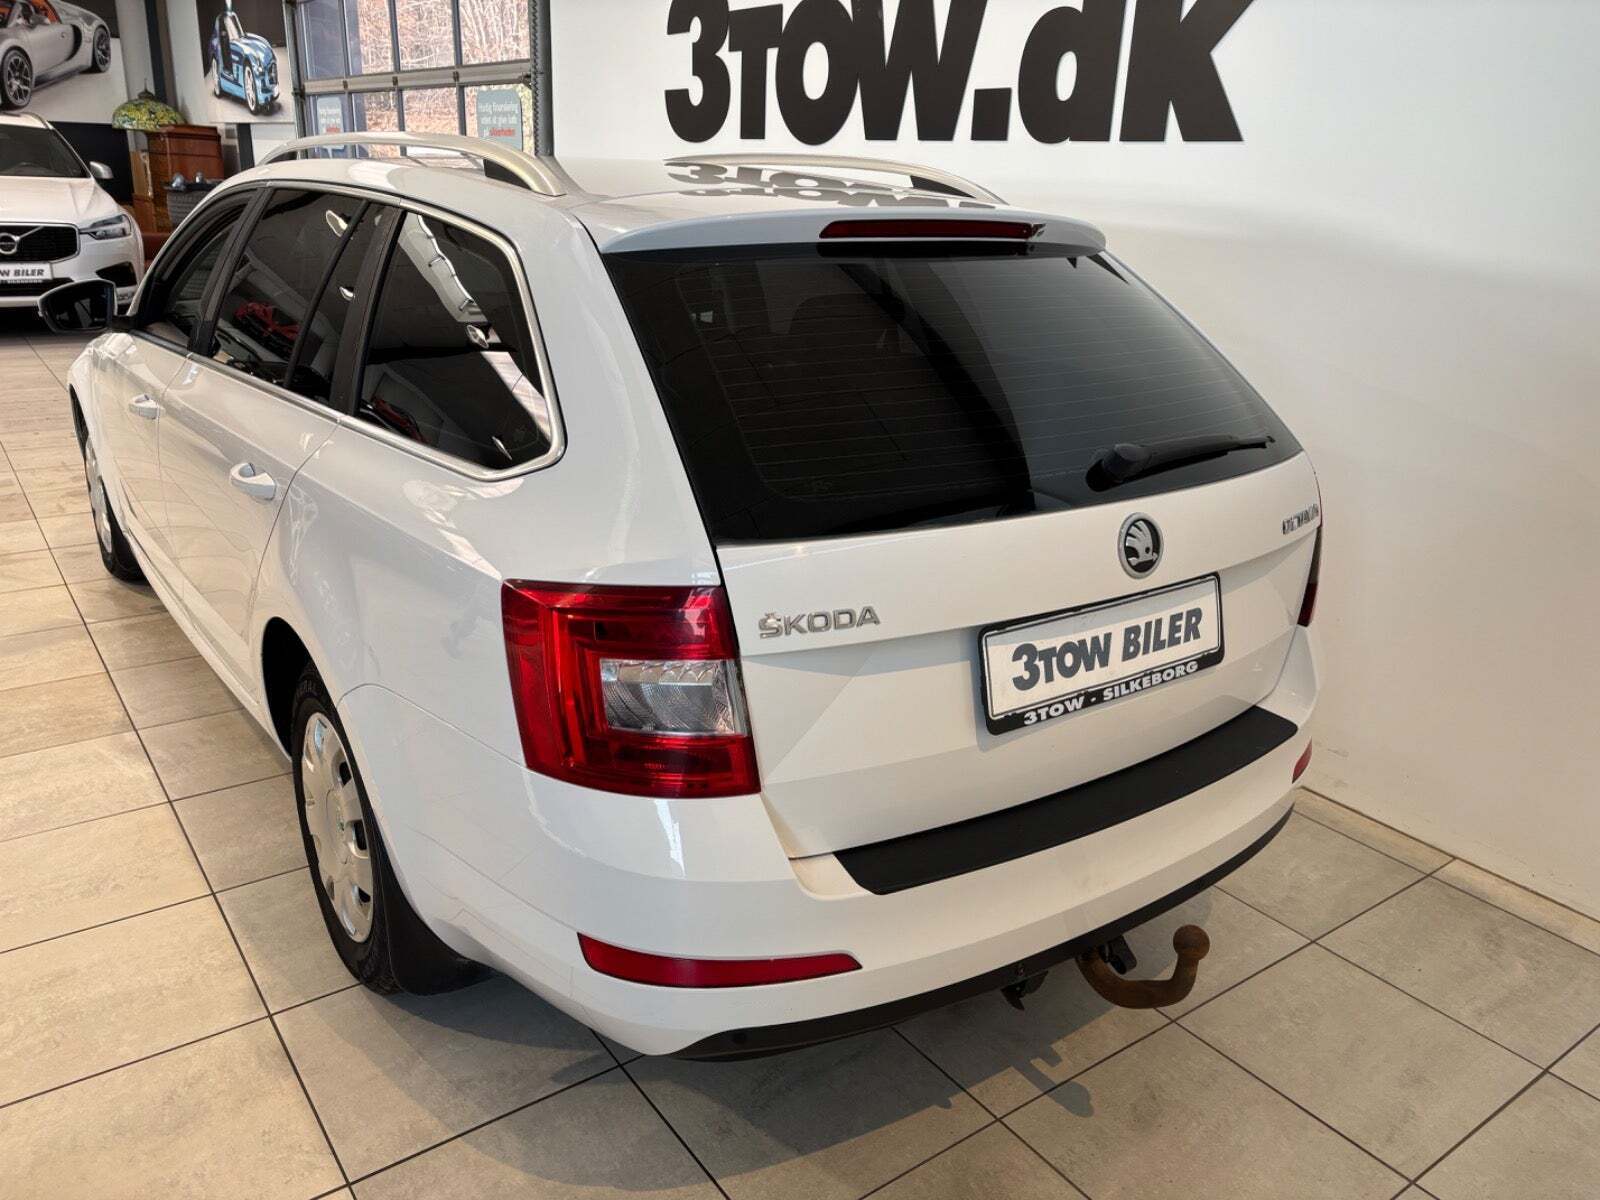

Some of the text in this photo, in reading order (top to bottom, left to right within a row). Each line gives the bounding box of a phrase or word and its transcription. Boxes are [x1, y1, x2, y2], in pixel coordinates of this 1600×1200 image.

[14, 268, 44, 277] BILER
[1011, 607, 1203, 692] 3TOW BILER
[1024, 695, 1085, 726] 3TOW
[1102, 660, 1199, 701] SILKEBORG
